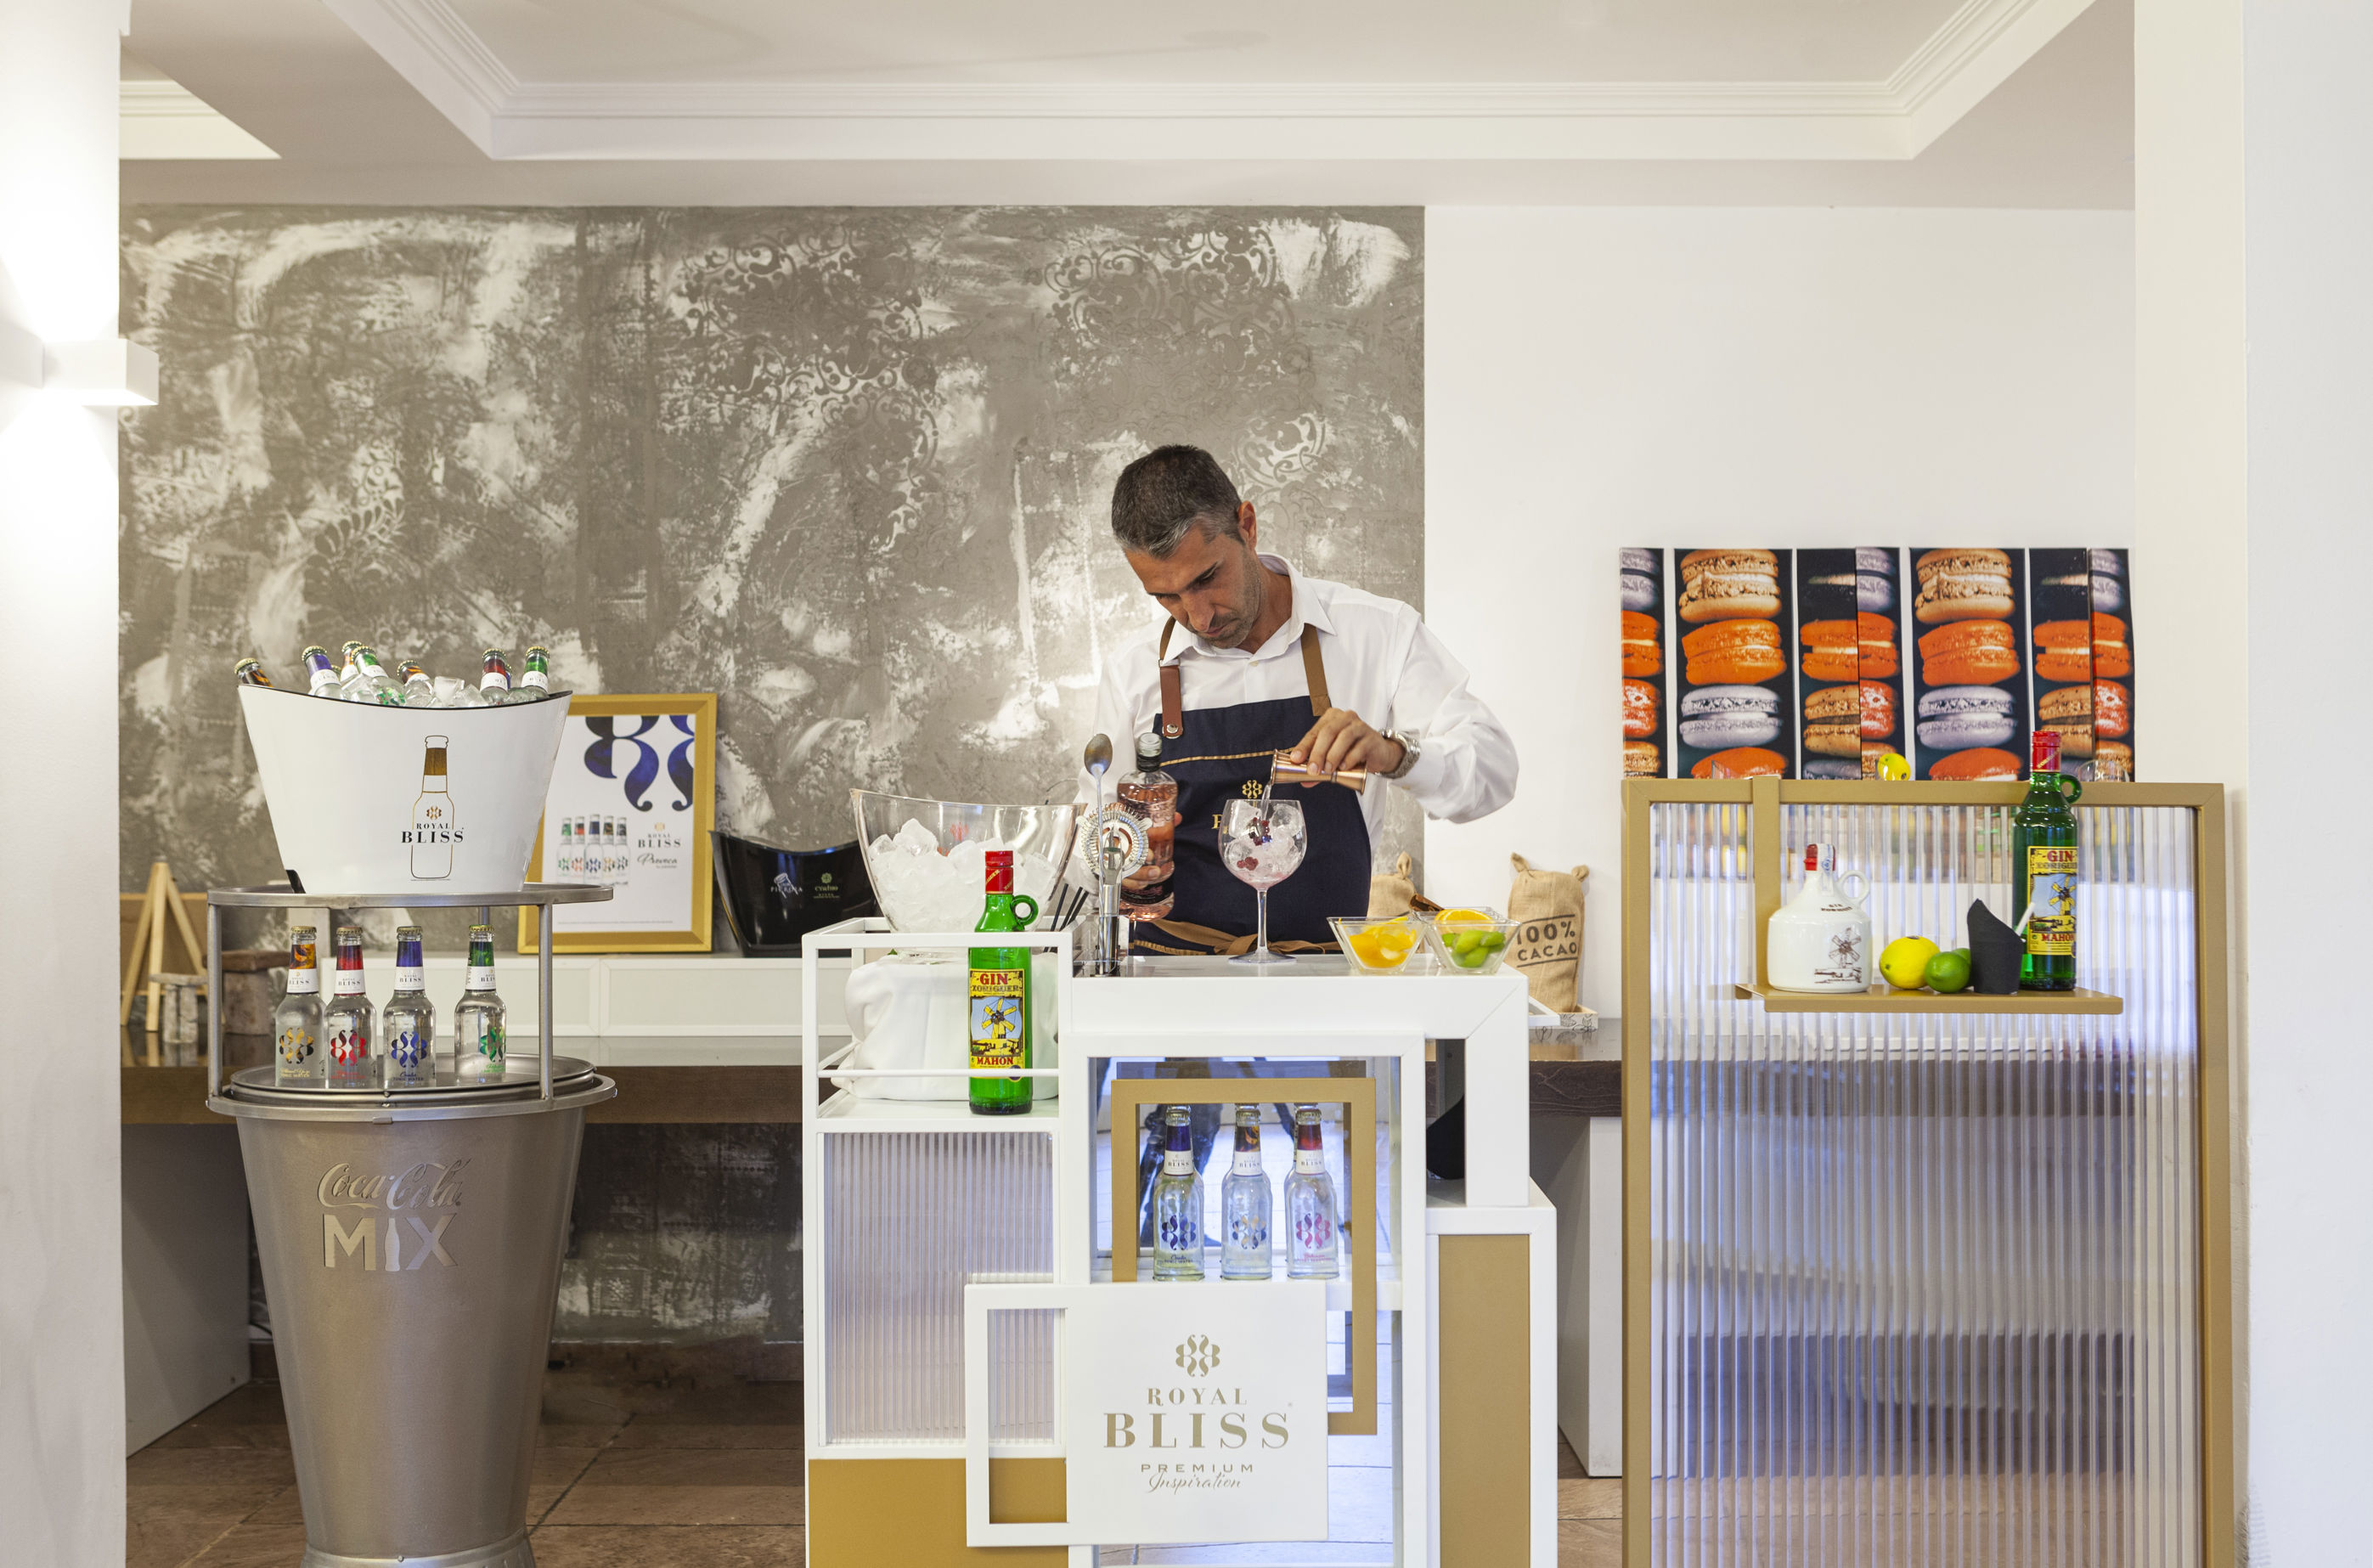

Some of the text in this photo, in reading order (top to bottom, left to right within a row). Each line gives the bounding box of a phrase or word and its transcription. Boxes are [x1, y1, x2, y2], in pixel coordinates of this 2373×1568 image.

[401, 831, 464, 843] BLISS
[638, 839, 681, 848] BLISS
[2047, 850, 2073, 862] GIN
[1517, 921, 1575, 945] 100%
[1518, 941, 1576, 961] CACAO
[980, 973, 1008, 985] GIN
[317, 1158, 472, 1210] Coca-Cola
[322, 1212, 459, 1272] MIX
[1147, 1387, 1247, 1407] ROYAL
[1103, 1412, 1289, 1449] BLISS
[1141, 1464, 1253, 1473] PREMIUM
[1146, 1469, 1243, 1495] Inspiration
